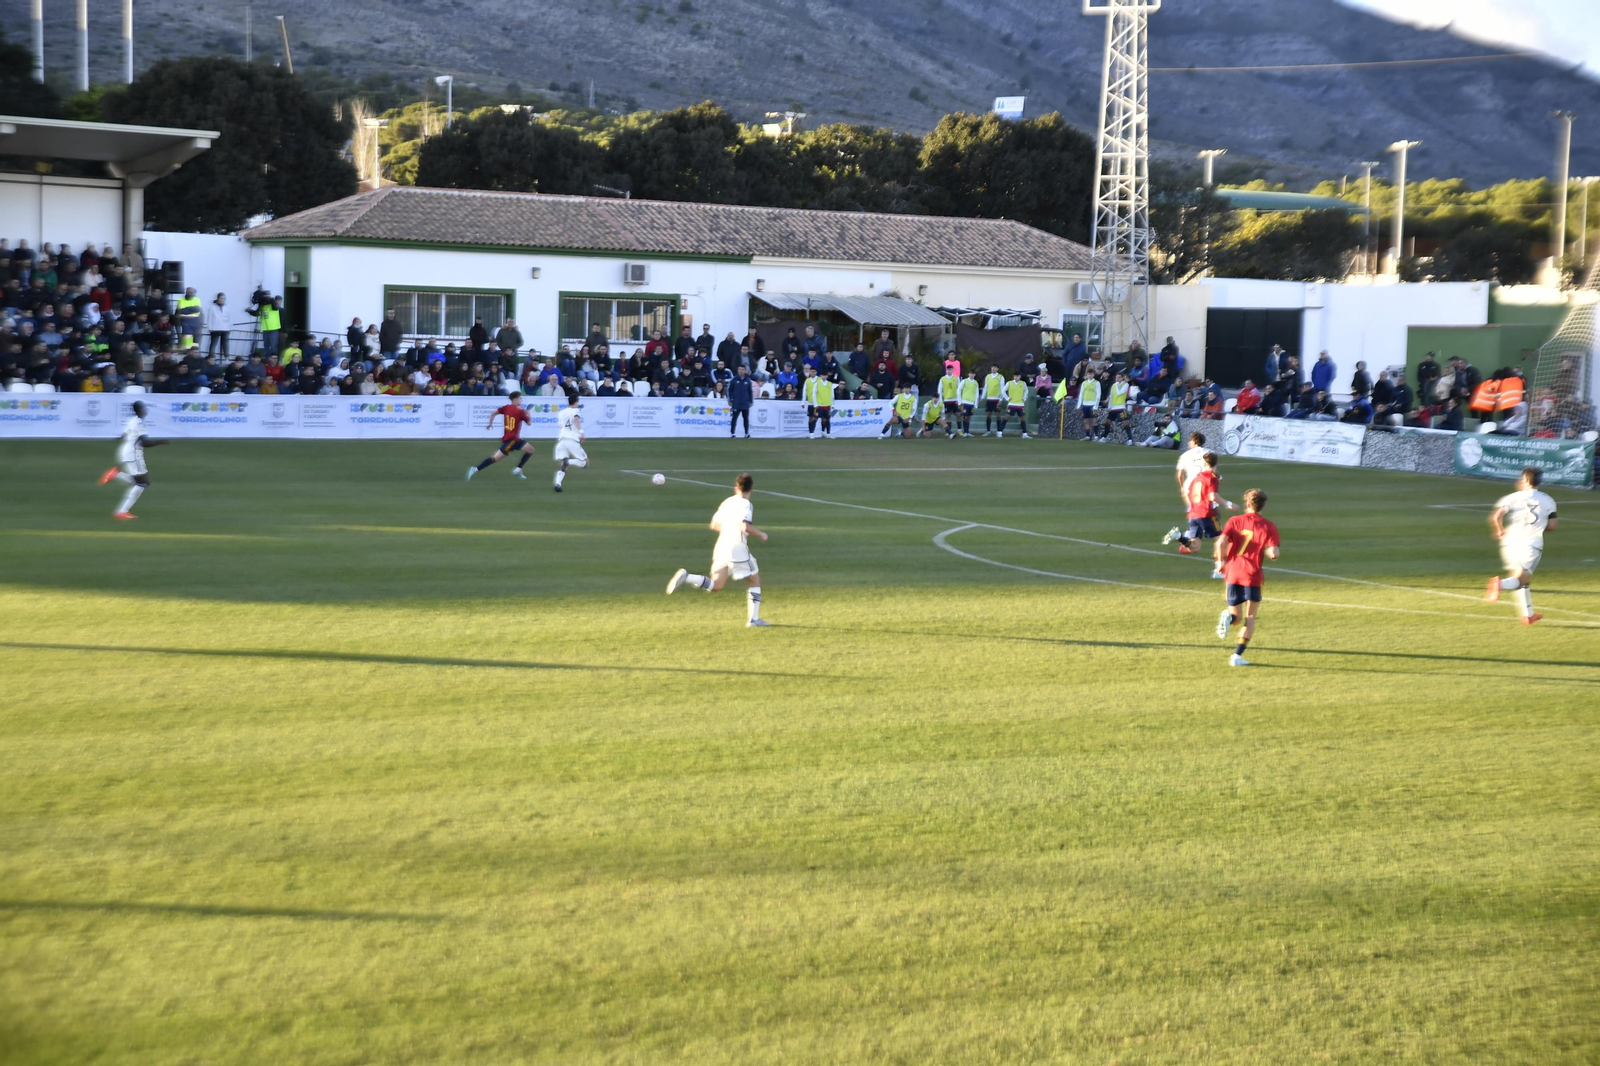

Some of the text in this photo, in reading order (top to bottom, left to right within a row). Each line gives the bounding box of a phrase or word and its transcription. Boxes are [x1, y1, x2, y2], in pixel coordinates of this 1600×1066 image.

[901, 402, 910, 410] 20
[505, 414, 515, 430] 10
[564, 419, 572, 430] 4
[1487, 438, 1519, 447] PESCADOS
[1525, 442, 1560, 450] MARISCOS
[1527, 504, 1539, 524] 3
[1238, 529, 1254, 556] 7
